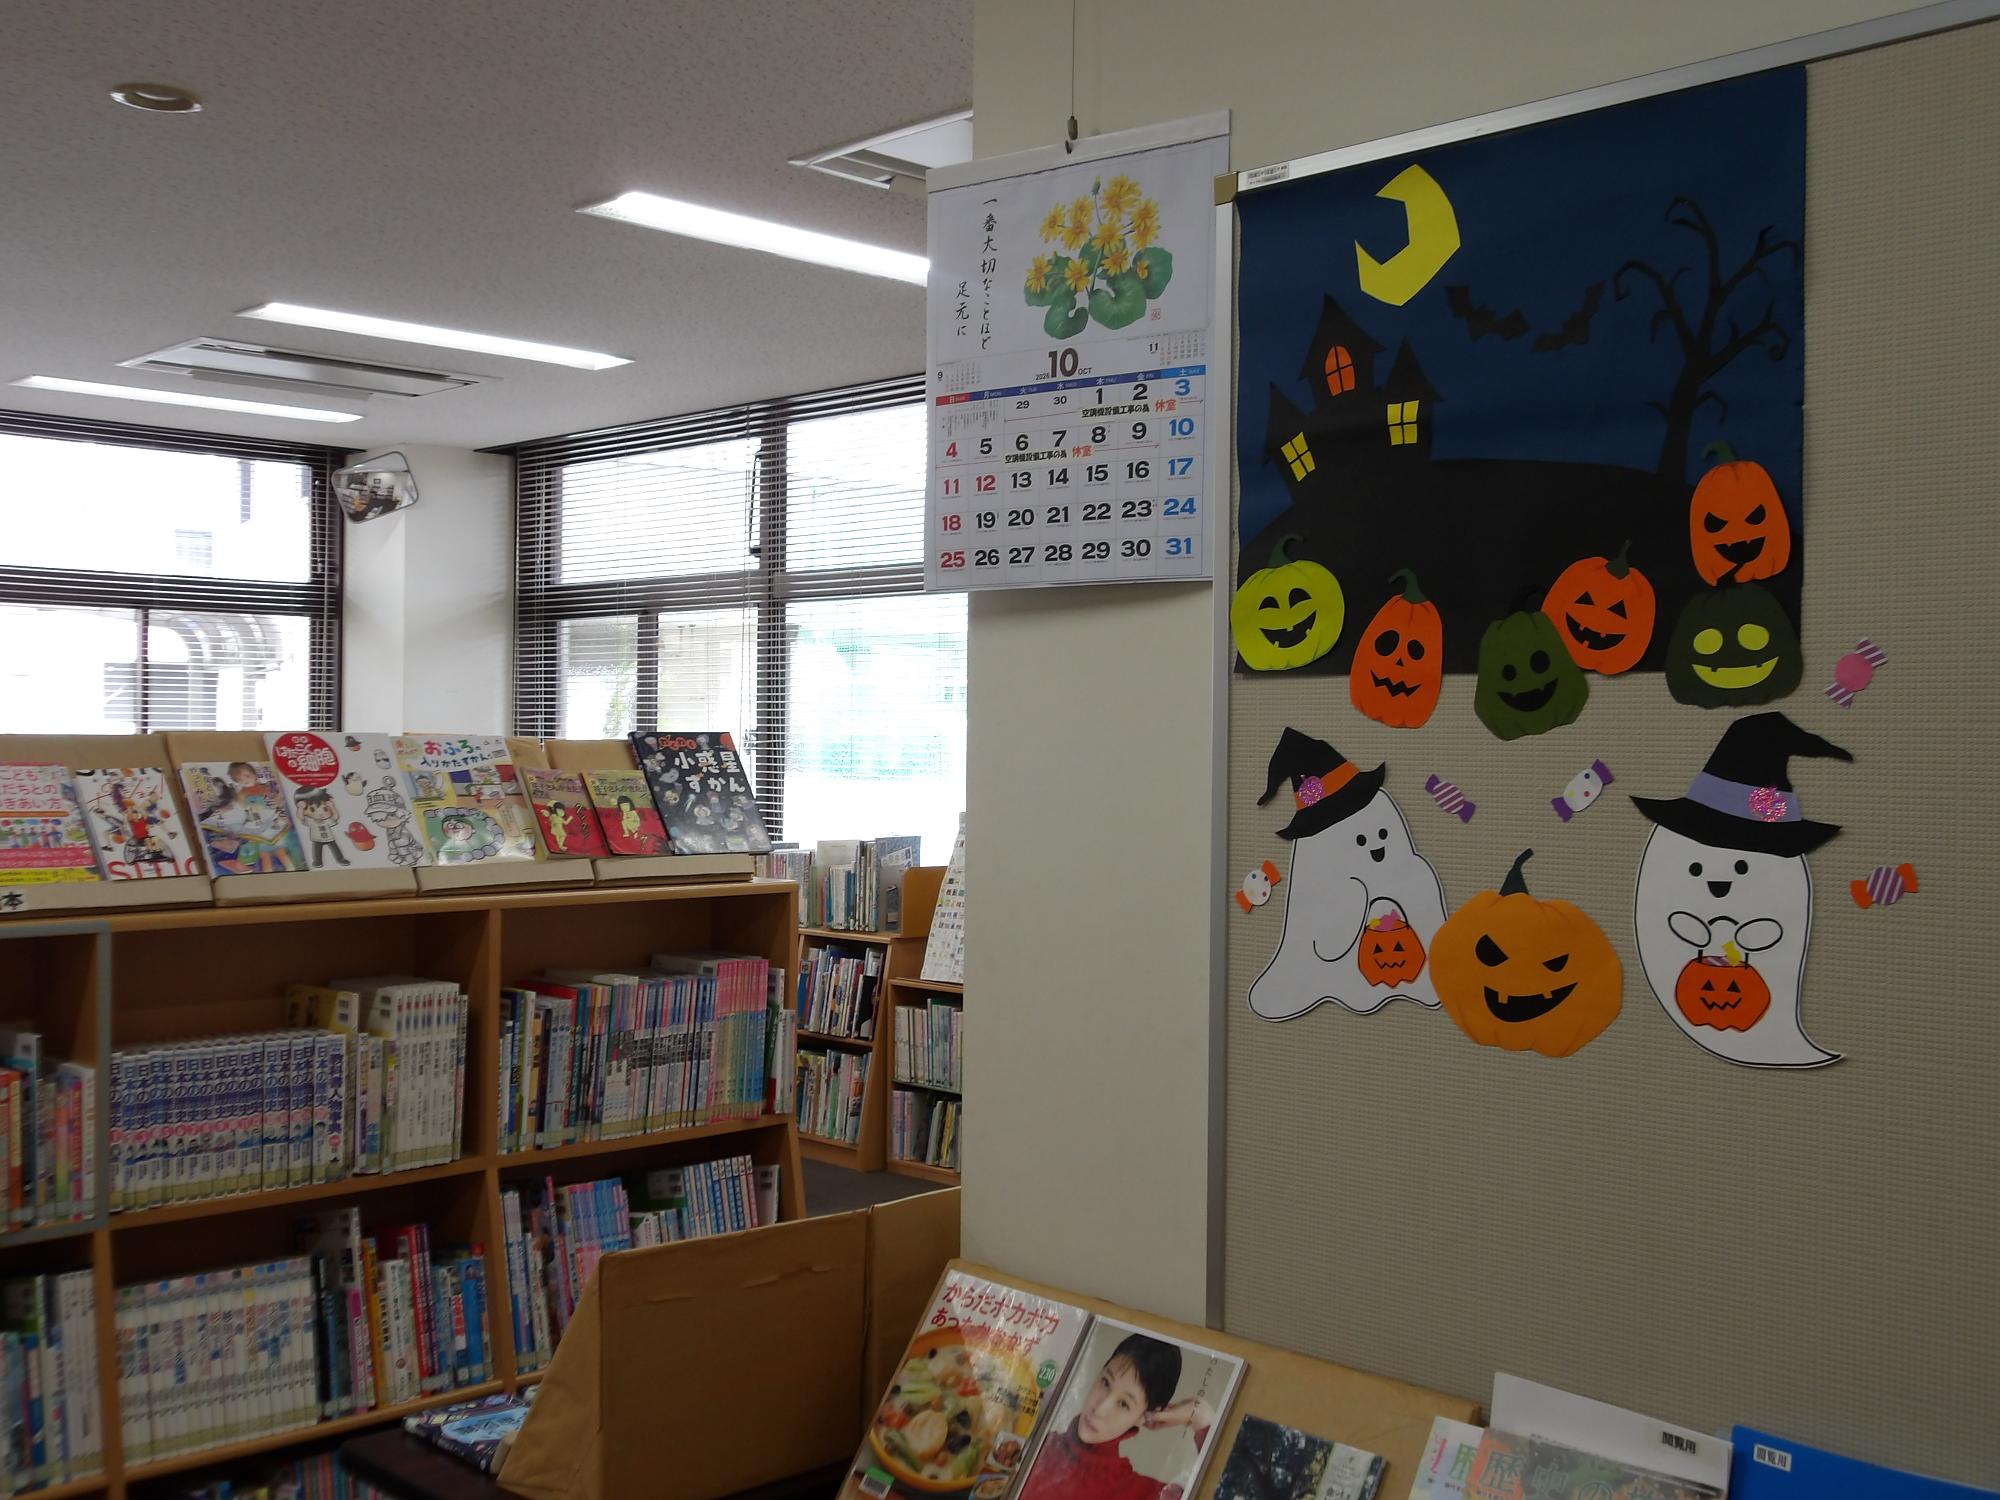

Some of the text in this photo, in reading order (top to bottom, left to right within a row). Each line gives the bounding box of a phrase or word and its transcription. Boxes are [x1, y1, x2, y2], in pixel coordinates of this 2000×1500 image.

[981, 199, 997, 350] 一番大切なことほど
[956, 281, 969, 335] 足元に
[1149, 343, 1158, 351] 11
[937, 371, 943, 379] 9
[1049, 348, 1078, 378] 10
[1078, 367, 1091, 375] OCT
[1016, 379, 1190, 410] 29 30 1 2 3
[1155, 399, 1176, 412] 休室
[946, 418, 1194, 457] 4 5 6 7 8 9 10
[1072, 445, 1092, 458] 休室
[944, 458, 1193, 495] 11 12 13 14 15 16 17
[942, 498, 1196, 531] 18 19 20 21 22 23 24
[940, 538, 1192, 568] 25 26 27 28 29 30 31
[675, 750, 741, 773] 小惑星
[1, 891, 24, 910] 本
[1038, 1367, 1056, 1381] 230
